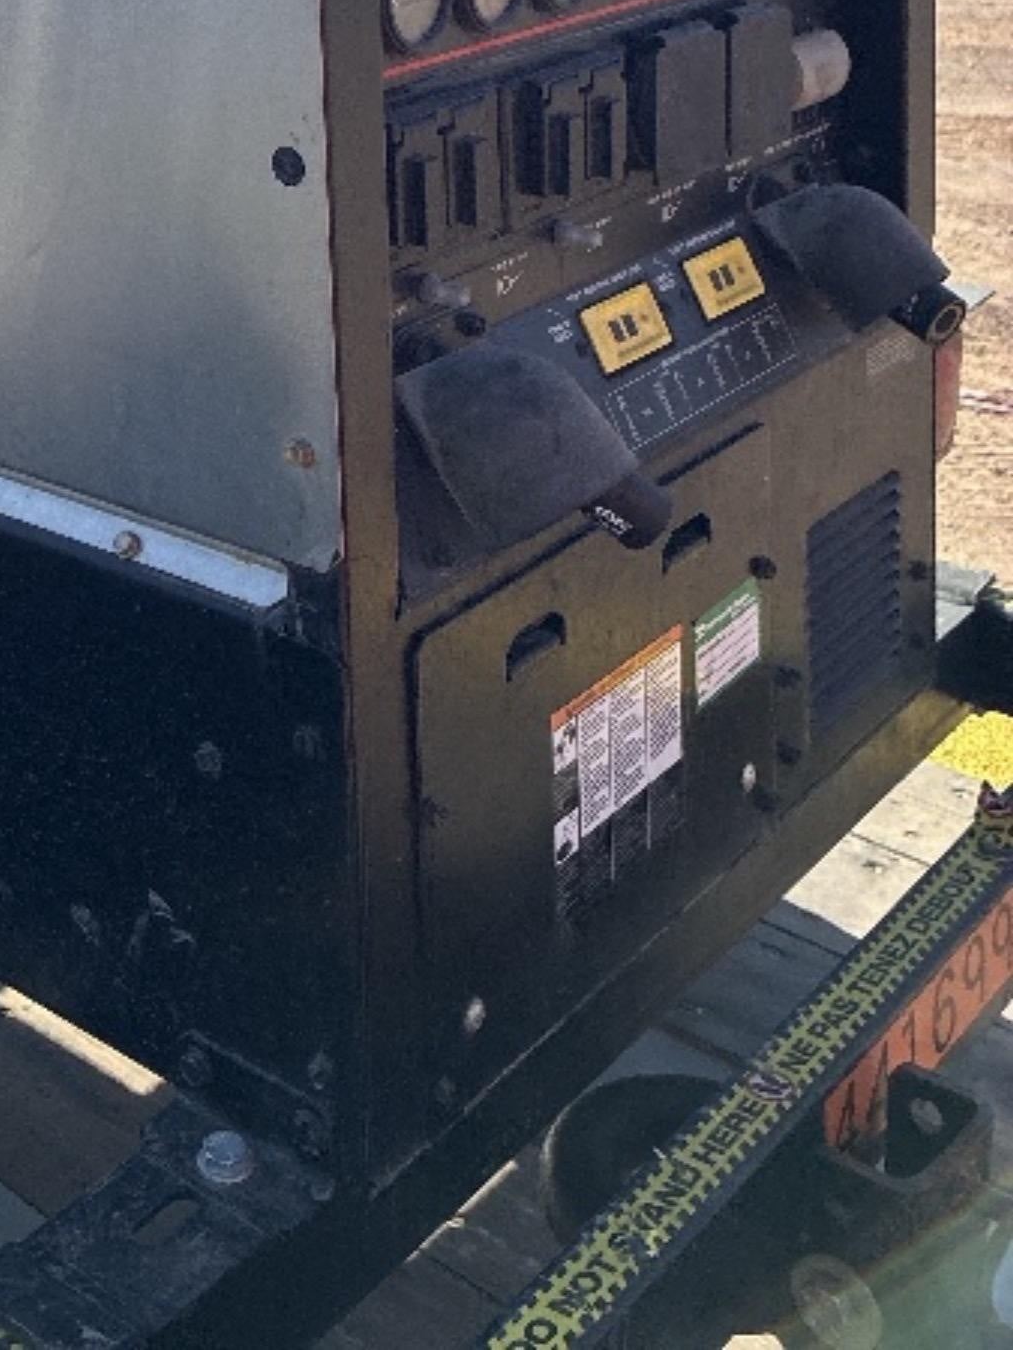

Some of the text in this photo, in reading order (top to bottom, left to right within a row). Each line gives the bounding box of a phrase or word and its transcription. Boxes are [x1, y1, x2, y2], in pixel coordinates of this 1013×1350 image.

[776, 1034, 820, 1075] NE
[806, 995, 860, 1041] PAS
[846, 930, 919, 995] TENEZ
[545, 1252, 619, 1319] NOT
[607, 1161, 704, 1252] SAND
[690, 1097, 768, 1164] HERE
